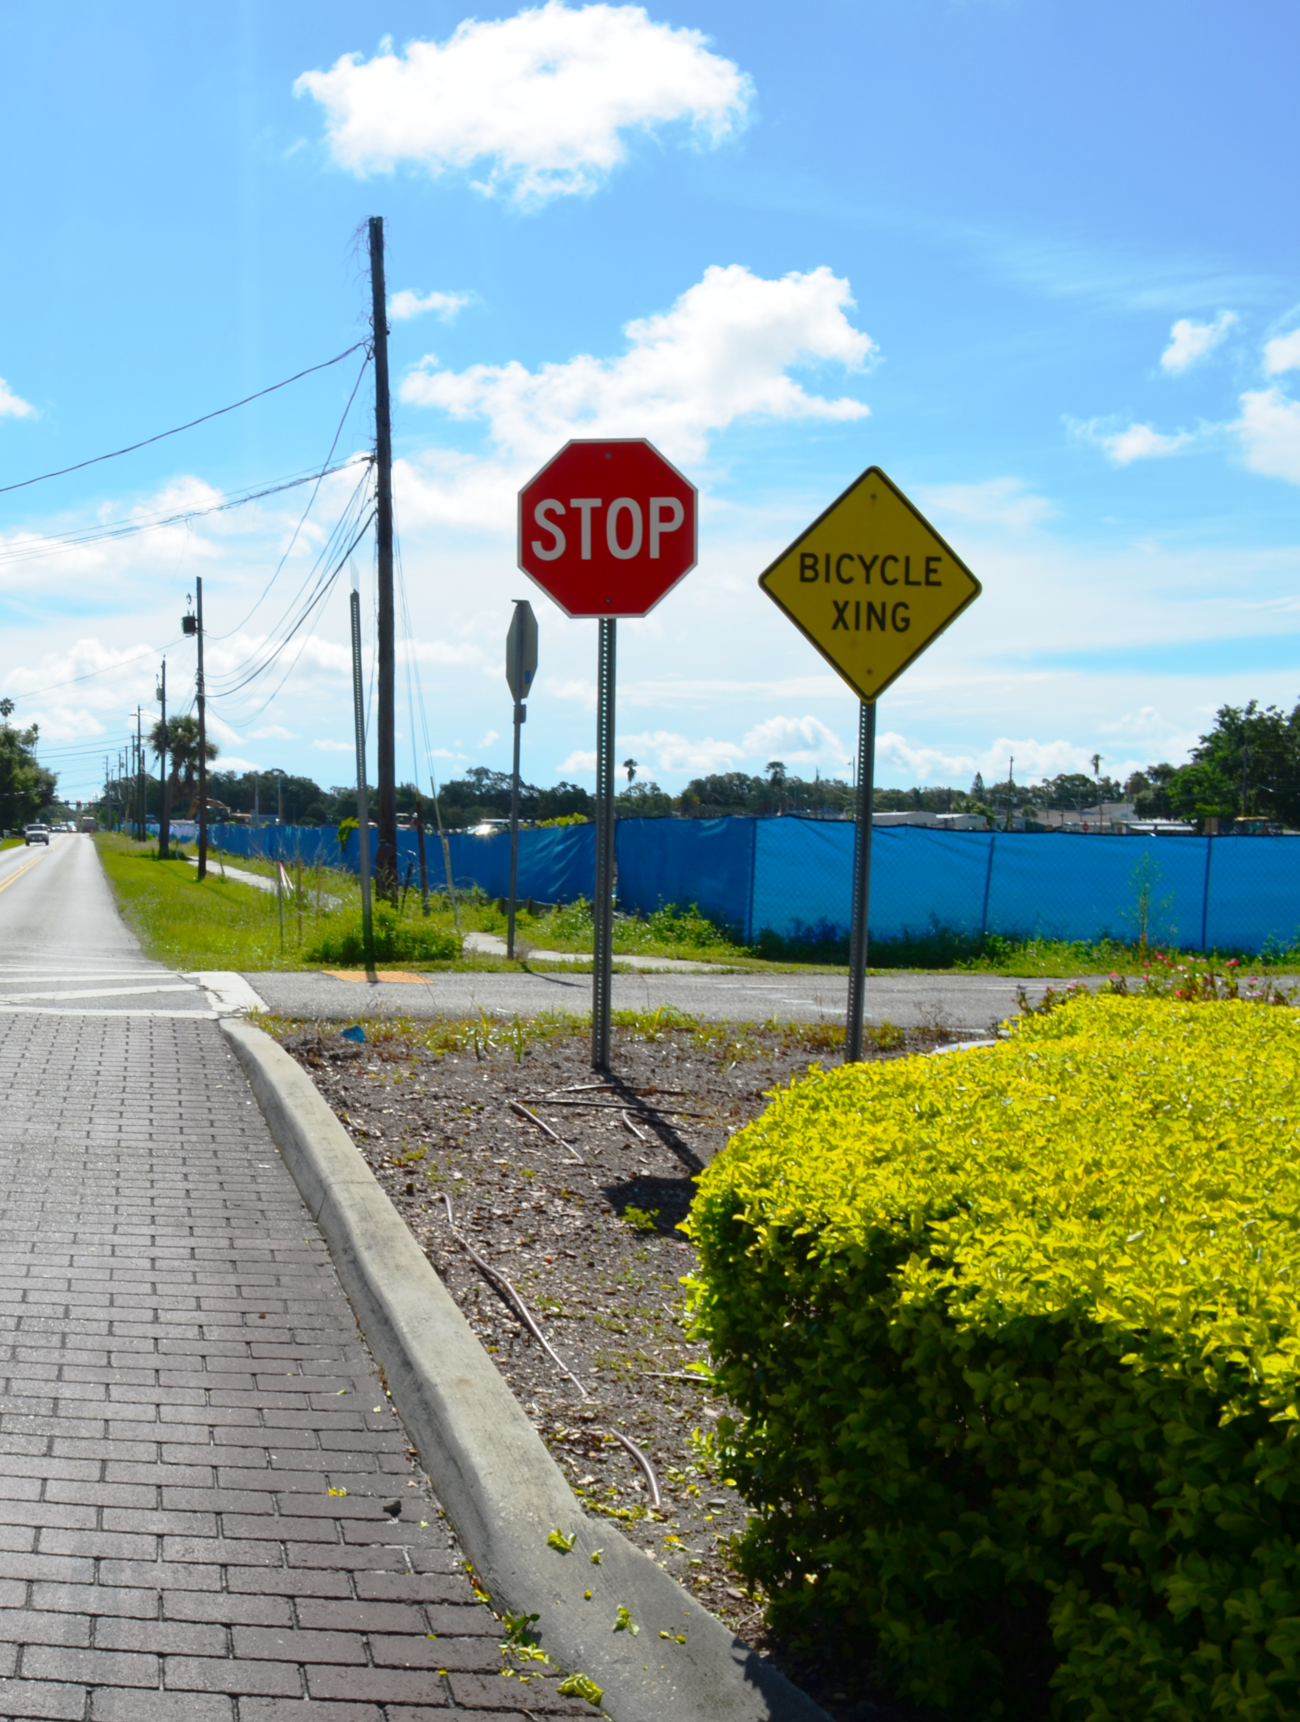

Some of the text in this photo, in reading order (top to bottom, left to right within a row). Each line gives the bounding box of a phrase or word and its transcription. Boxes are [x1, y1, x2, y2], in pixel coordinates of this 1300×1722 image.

[531, 496, 684, 561] STOP
[799, 552, 943, 587] BICYCLE
[831, 600, 911, 633] XING
